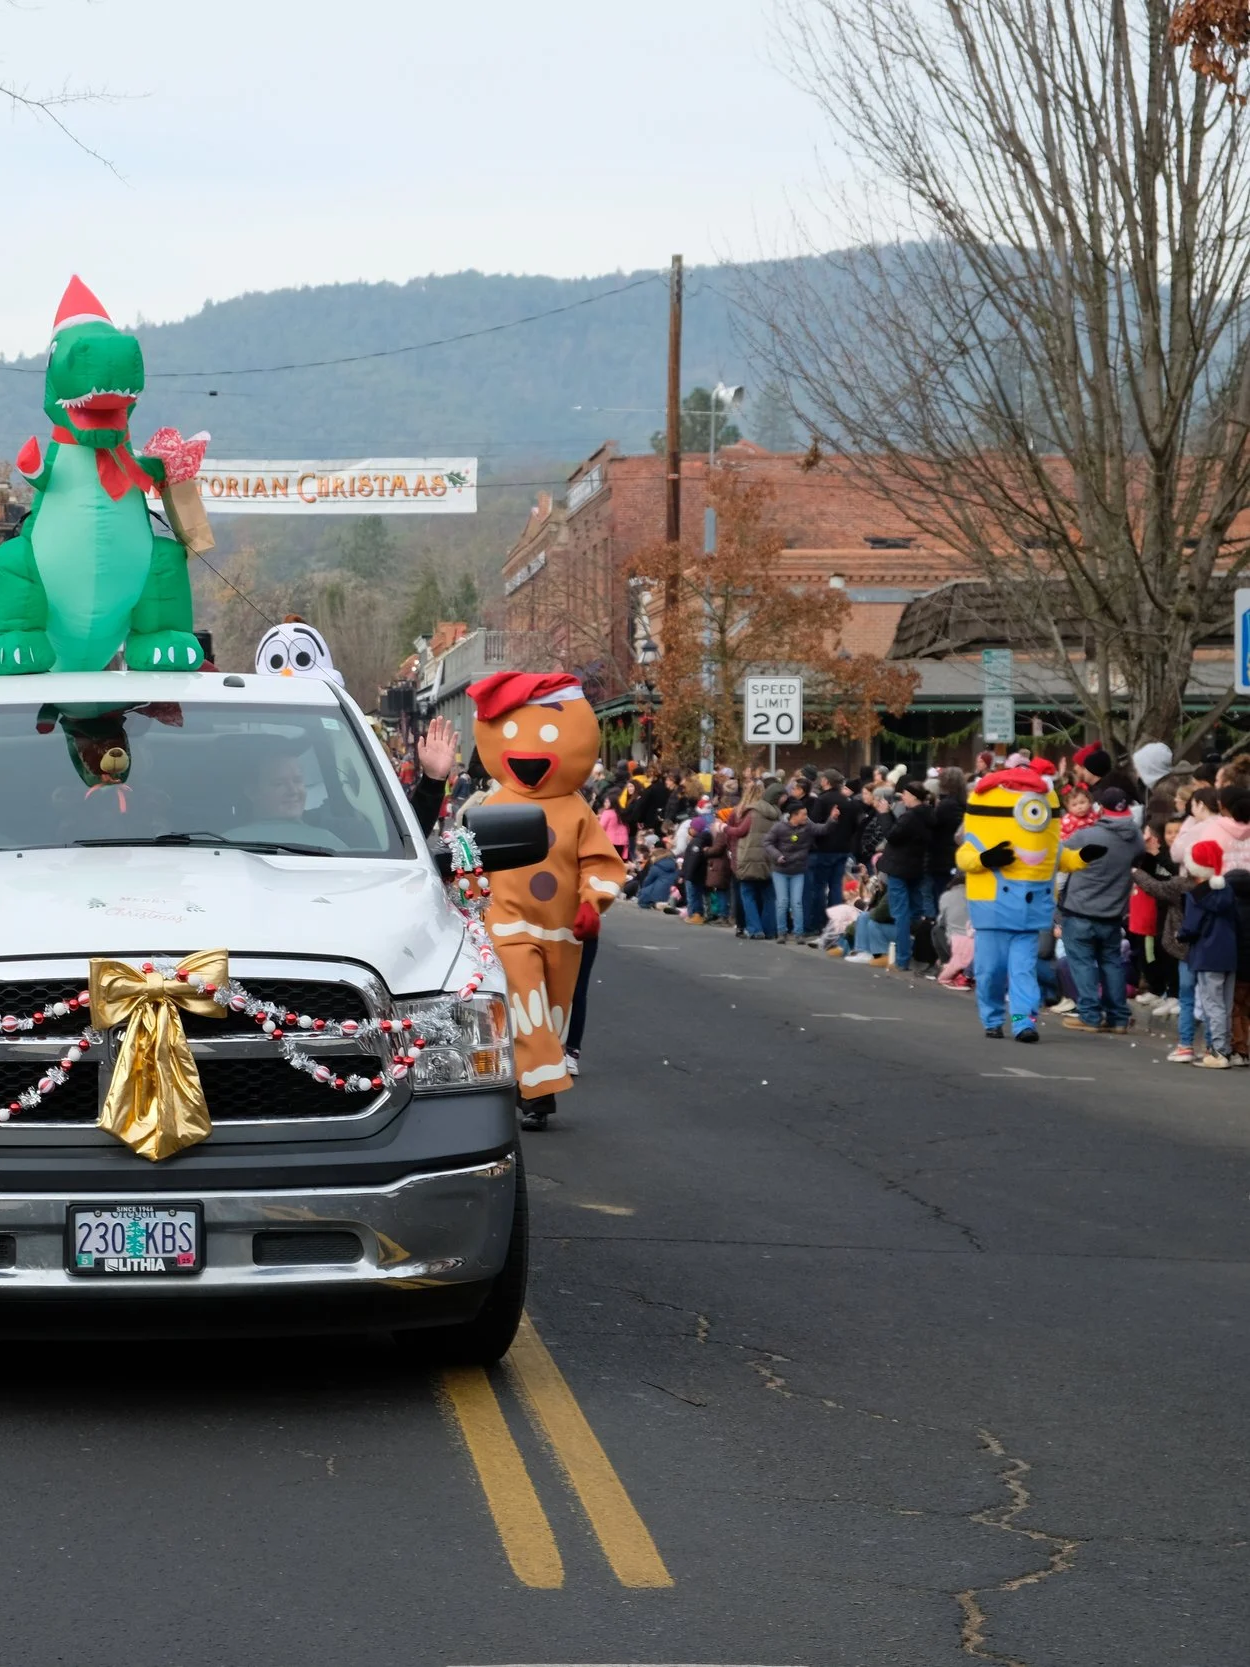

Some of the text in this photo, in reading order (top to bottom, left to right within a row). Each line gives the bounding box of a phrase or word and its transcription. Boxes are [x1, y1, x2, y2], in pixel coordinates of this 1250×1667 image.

[153, 471, 448, 504] TORIAN CHRISTMAS
[751, 684, 797, 695] SPEED
[756, 698, 792, 708] LIMIT
[753, 712, 795, 735] 20
[77, 1222, 193, 1254] 230 KBS
[81, 1255, 89, 1265] 5
[118, 1258, 166, 1271] LITHIA
